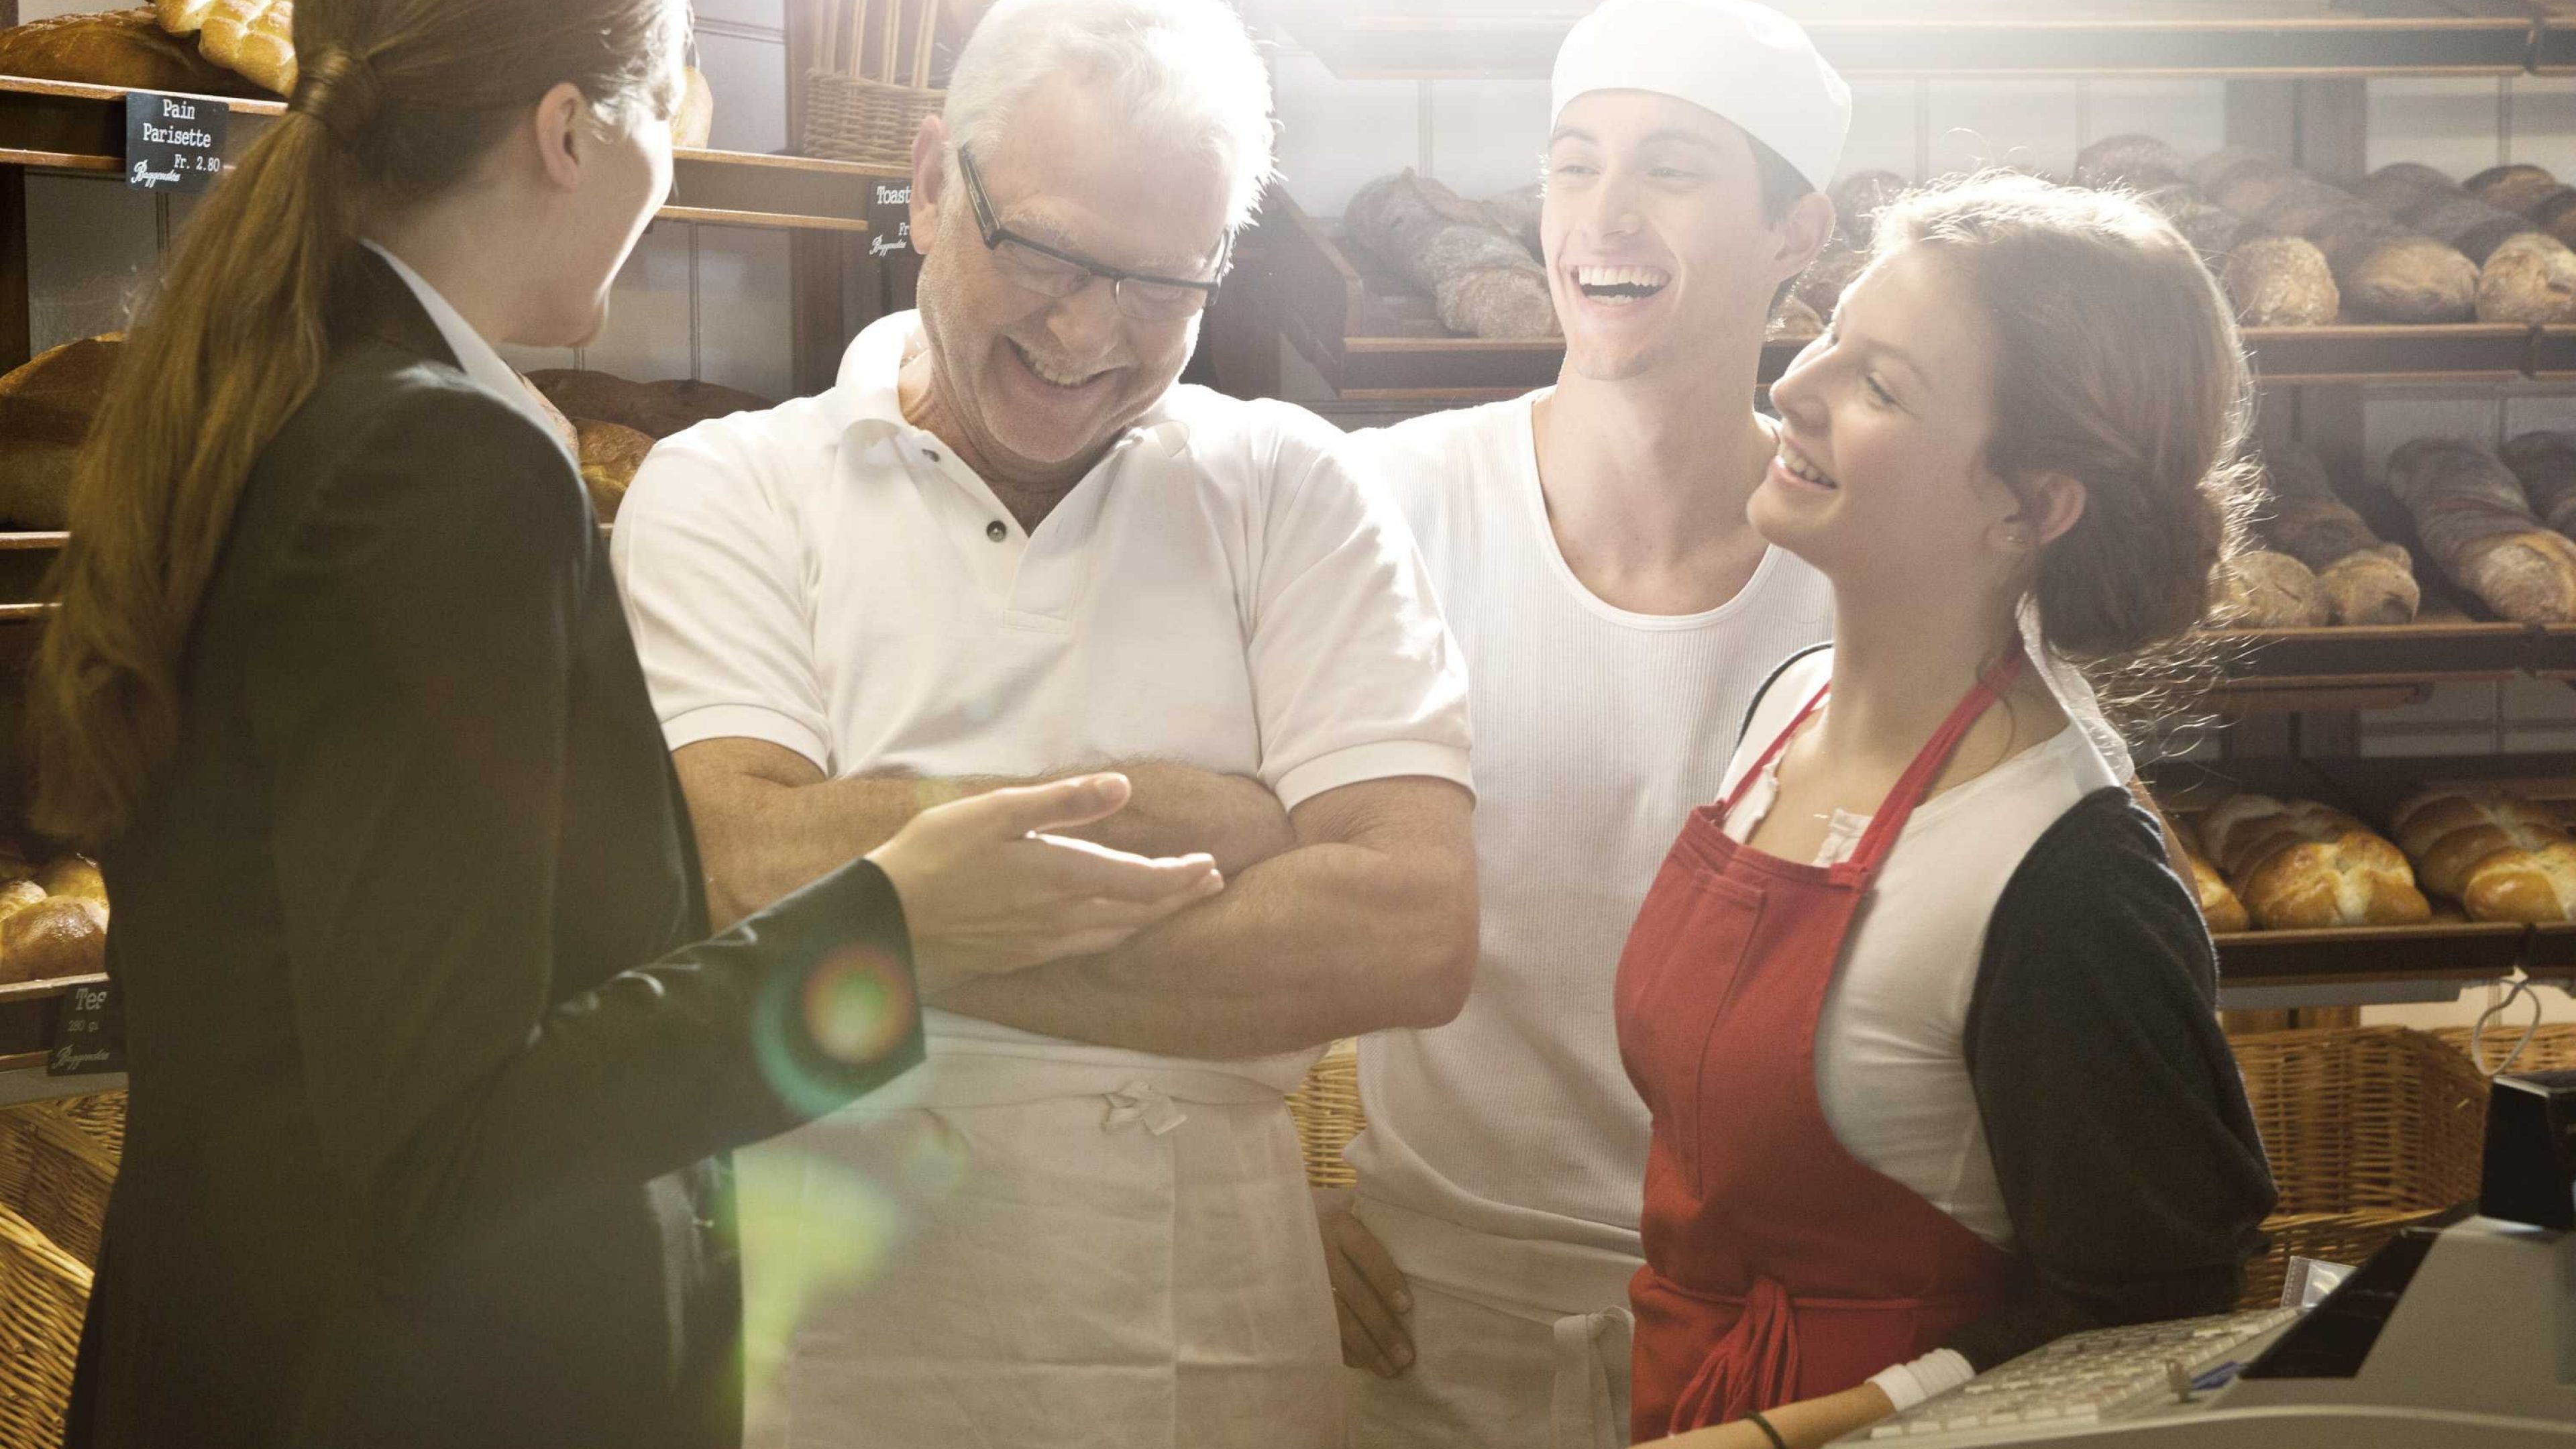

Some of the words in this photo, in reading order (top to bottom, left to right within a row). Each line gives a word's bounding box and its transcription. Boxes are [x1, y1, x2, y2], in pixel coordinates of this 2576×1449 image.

[163, 99, 195, 119] Pain
[142, 122, 211, 148] Parisette
[174, 154, 191, 169] Fr.
[196, 156, 220, 172] 2.80
[876, 184, 912, 205] Toast
